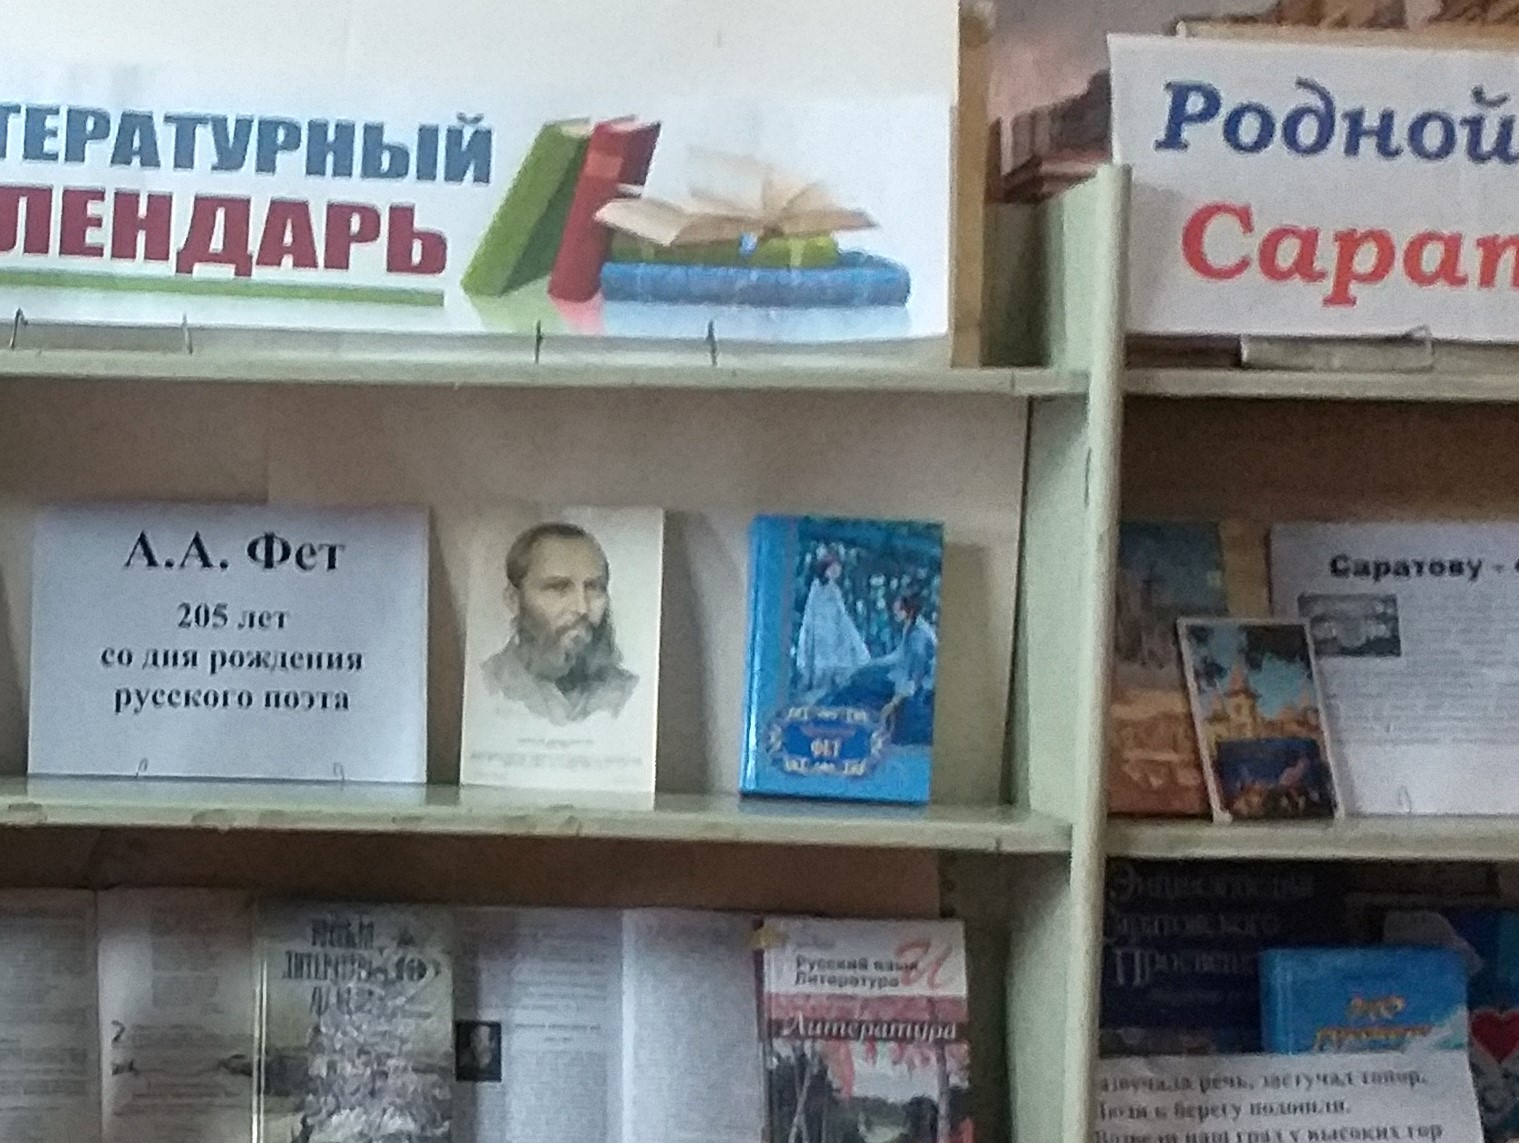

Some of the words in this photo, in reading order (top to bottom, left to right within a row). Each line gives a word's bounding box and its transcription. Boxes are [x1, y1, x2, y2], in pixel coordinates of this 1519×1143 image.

[1155, 76, 1519, 163] Родной
[124, 530, 229, 569] А.А.
[246, 531, 346, 571] Фет
[1330, 553, 1482, 582] Саратову
[177, 602, 228, 629] 205
[238, 607, 291, 629] лет
[100, 646, 133, 666] со
[142, 647, 199, 670] дня
[210, 648, 364, 675] рождения
[114, 686, 253, 715] русского
[264, 686, 350, 710] поэта
[796, 954, 869, 972] Русский
[795, 971, 900, 989] Литература
[782, 1012, 957, 1043] Литература
[1307, 1126, 1400, 1143] высоких
